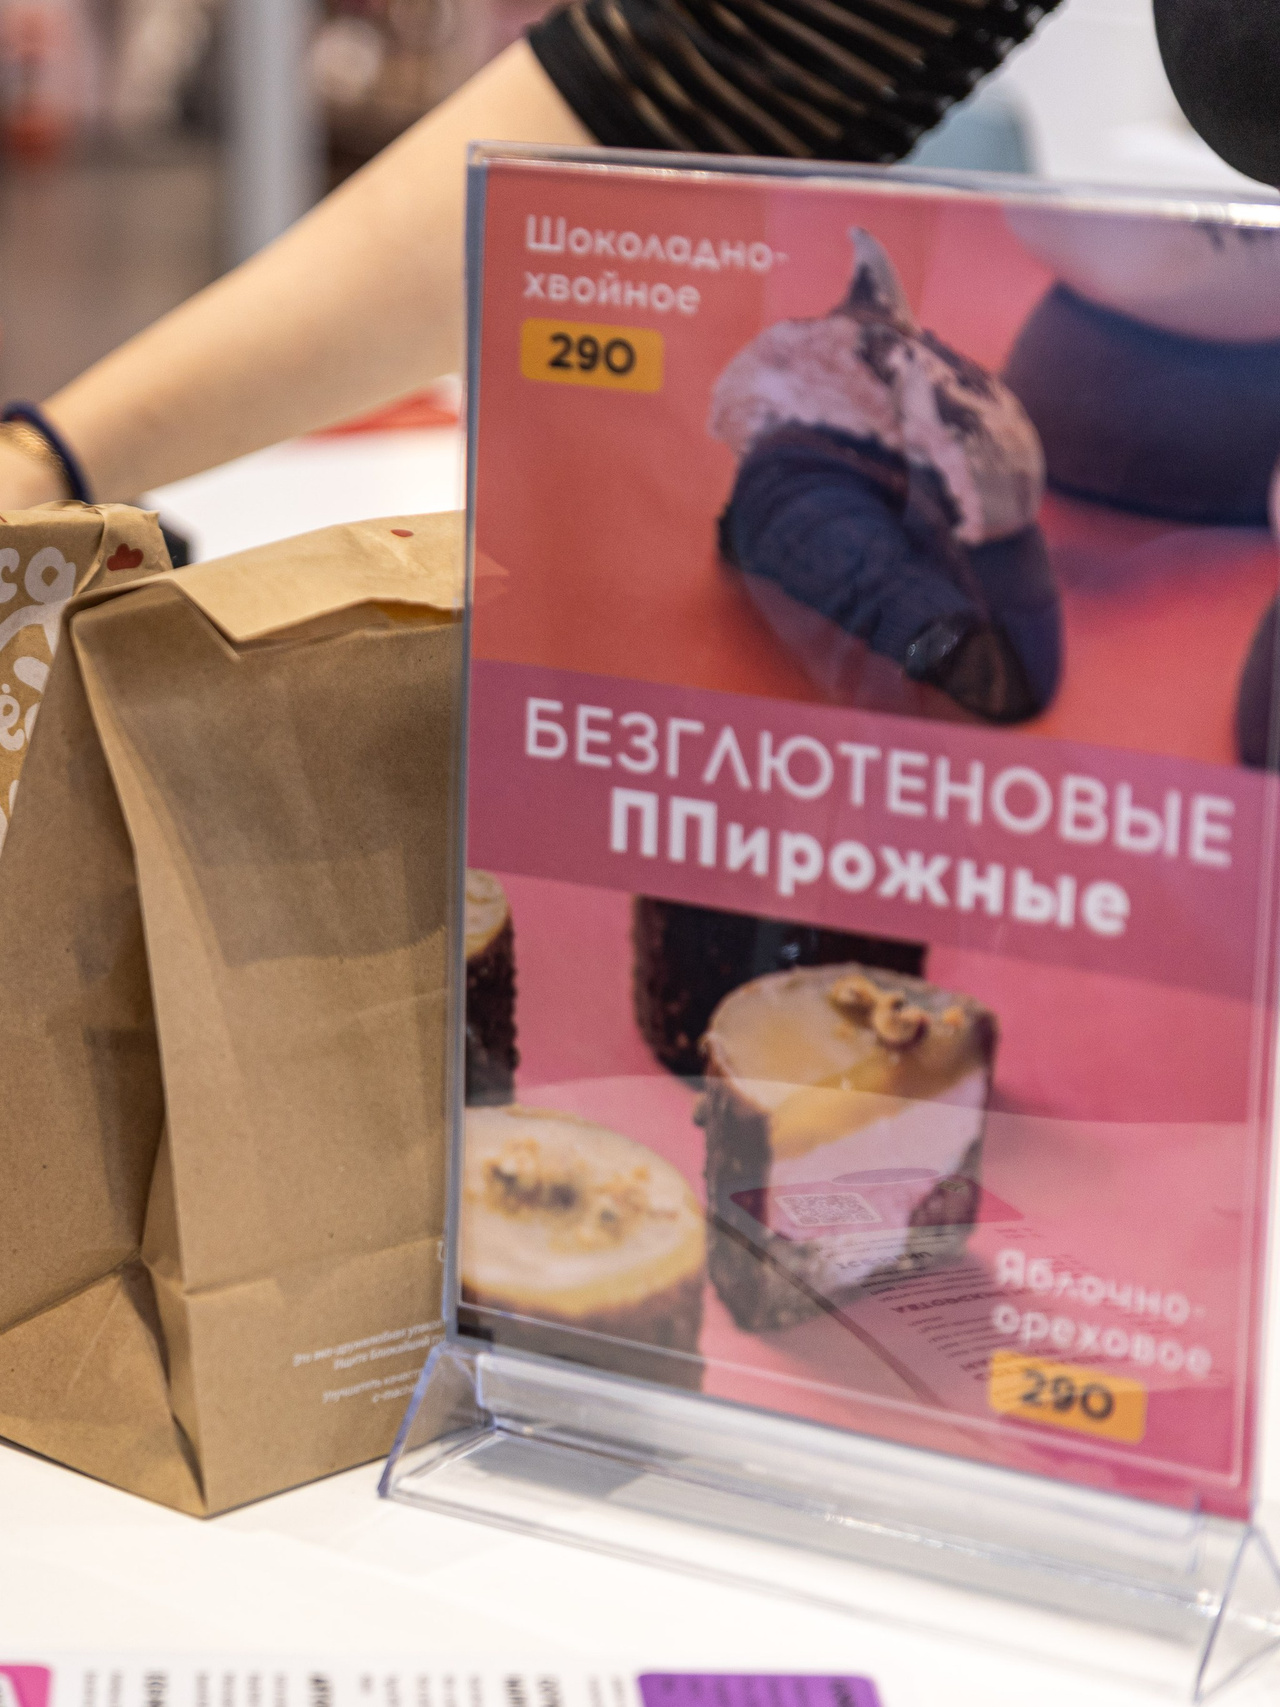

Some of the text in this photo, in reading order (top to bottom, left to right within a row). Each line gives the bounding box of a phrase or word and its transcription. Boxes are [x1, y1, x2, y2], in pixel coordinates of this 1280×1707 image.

[525, 213, 789, 273] Шоколадно-
[523, 270, 701, 316] хвойное
[548, 331, 637, 377] 290
[525, 697, 1235, 867] БЕЗГЛЮТЕНОВЫЕ
[609, 787, 1131, 936] ППирожные
[996, 1248, 1207, 1325] Яблочно-
[992, 1304, 1212, 1380] ореховое
[1021, 1368, 1116, 1422] 290
